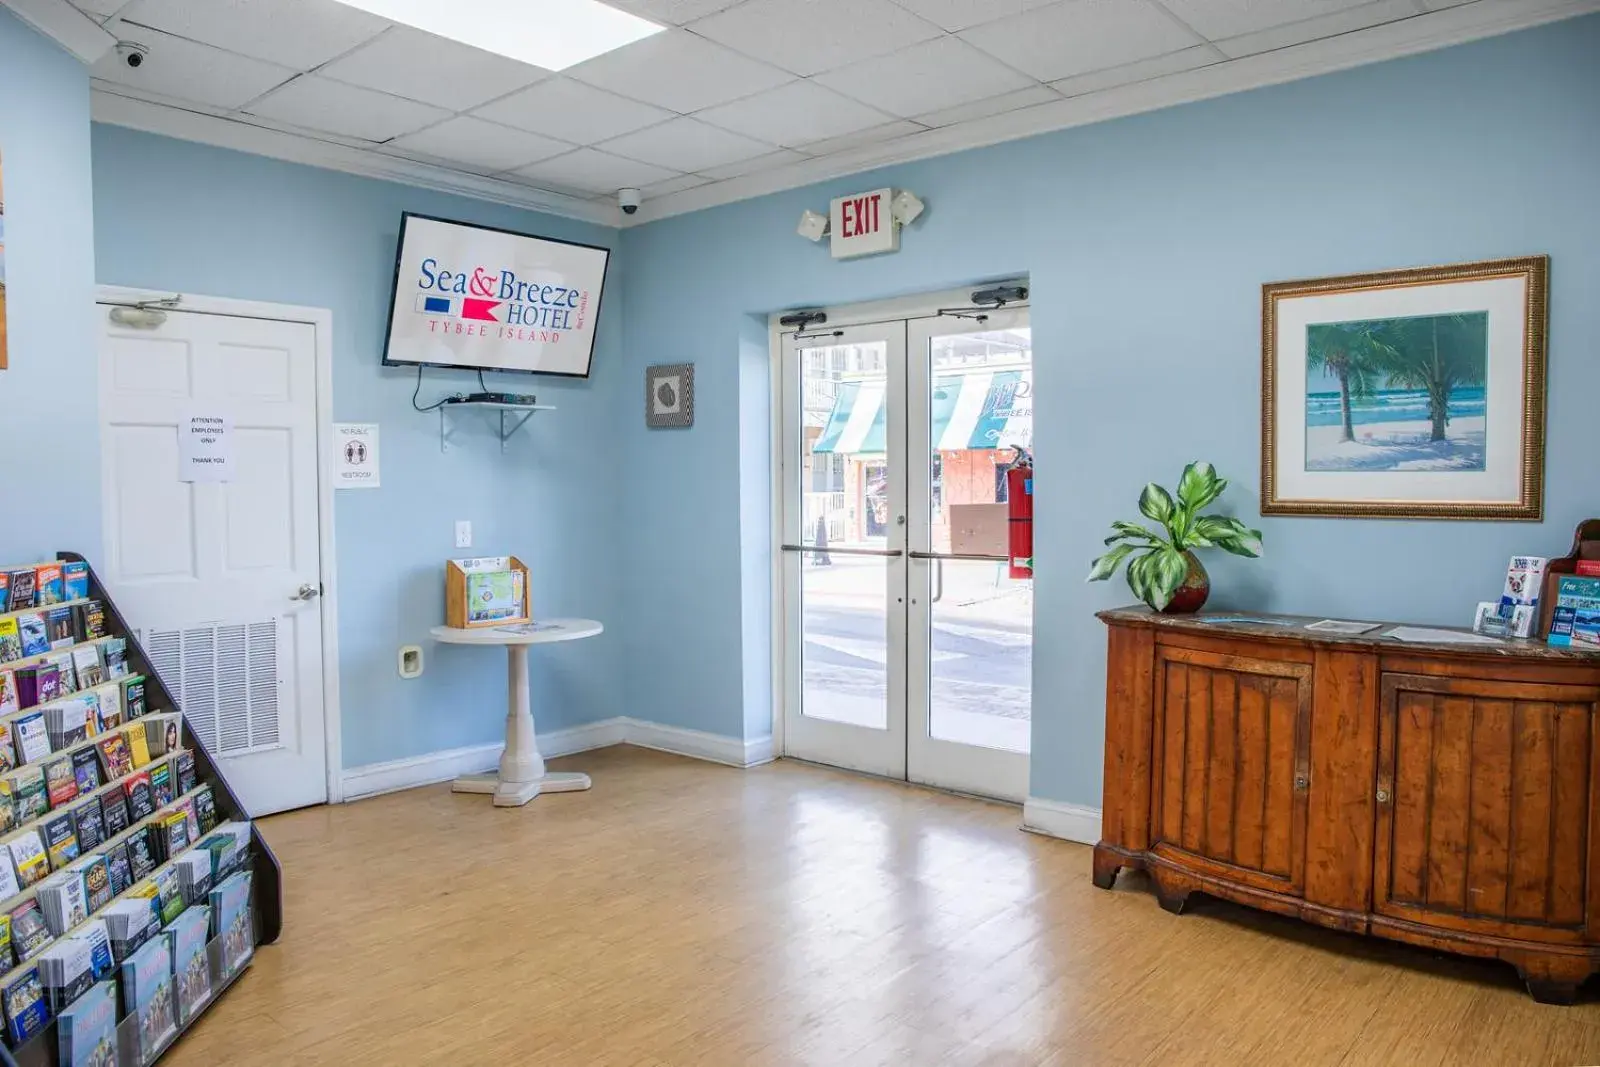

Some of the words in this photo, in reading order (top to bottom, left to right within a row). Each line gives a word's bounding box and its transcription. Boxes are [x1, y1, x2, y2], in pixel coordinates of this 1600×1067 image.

[842, 194, 881, 238] EXIT
[507, 303, 573, 330] HOTEL
[429, 320, 489, 337] TYBEE
[498, 327, 560, 344] ISLAND
